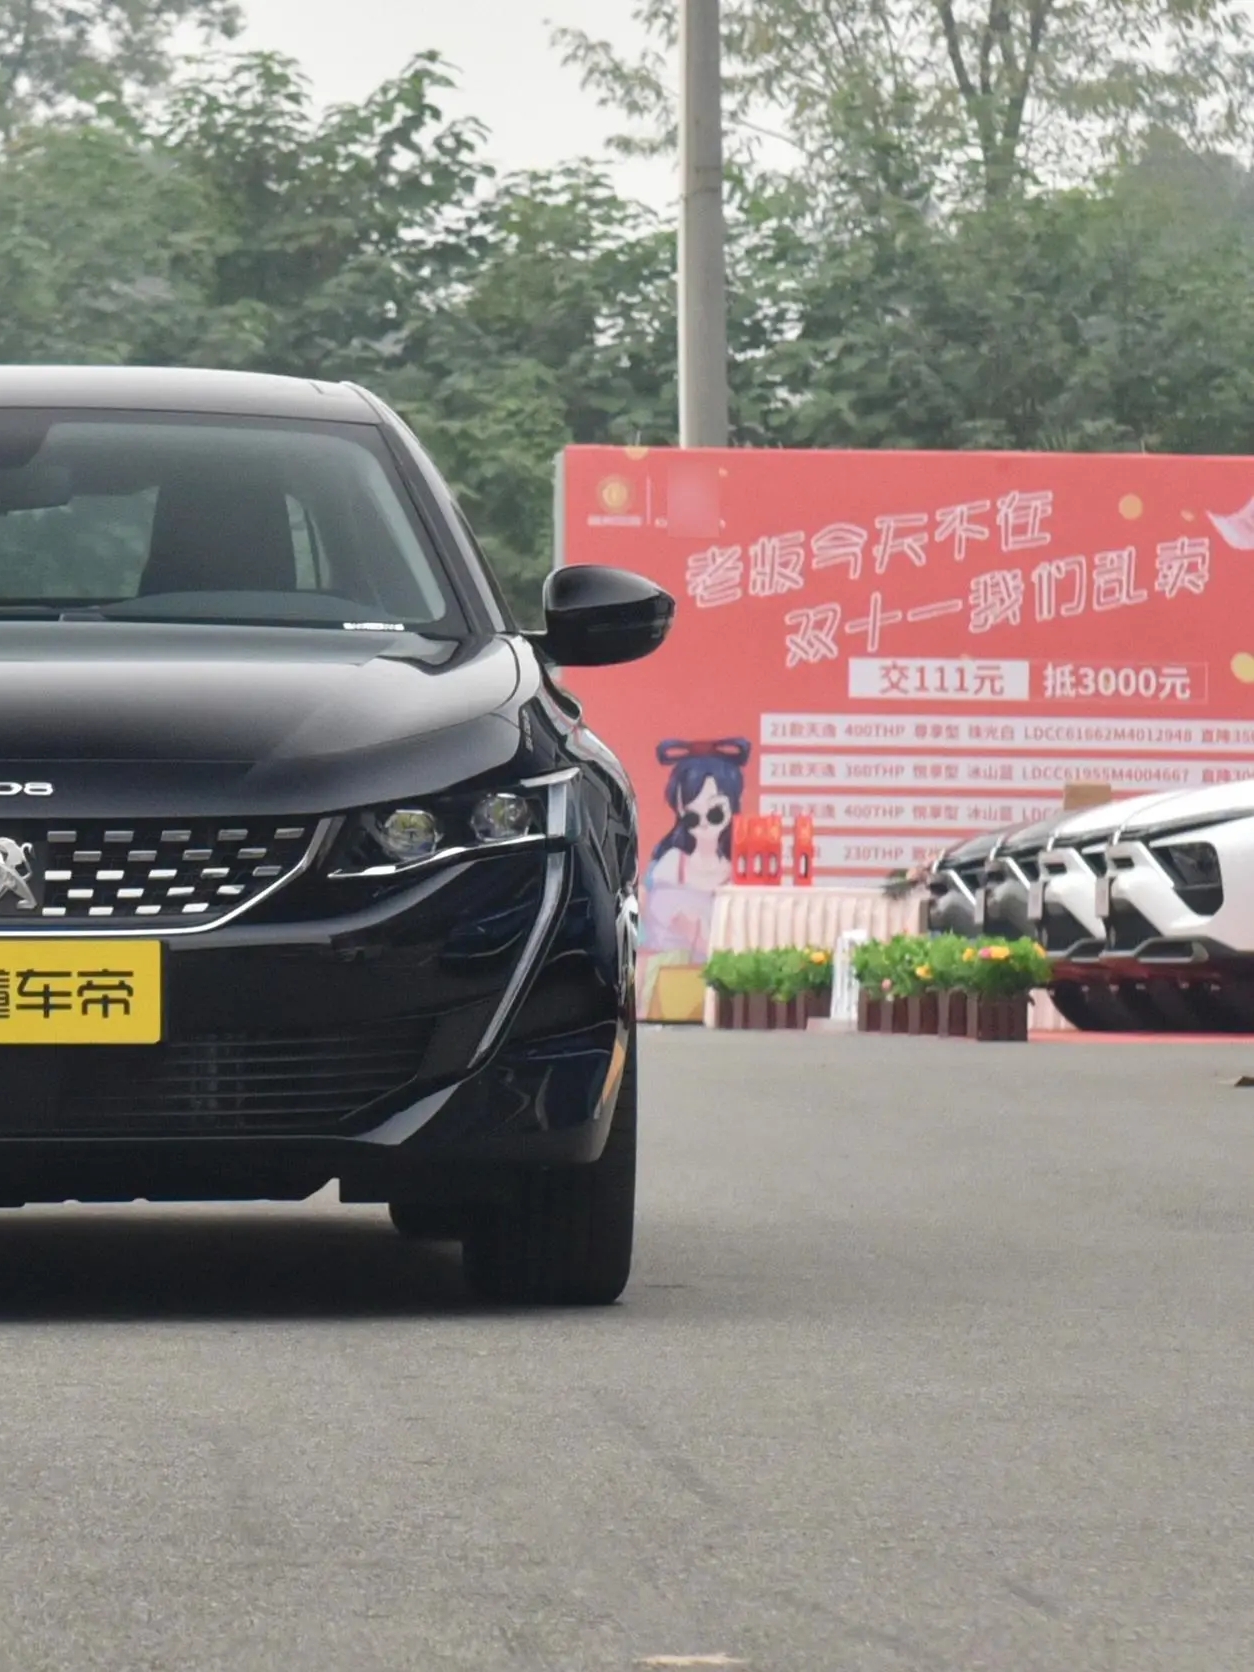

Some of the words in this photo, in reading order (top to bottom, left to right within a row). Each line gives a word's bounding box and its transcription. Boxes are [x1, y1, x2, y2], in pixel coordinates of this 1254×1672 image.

[685, 490, 1053, 608] 老板今天不在
[878, 660, 1005, 697] 交111元
[1042, 661, 1192, 700] 抵3000元
[844, 723, 905, 739] 400THP
